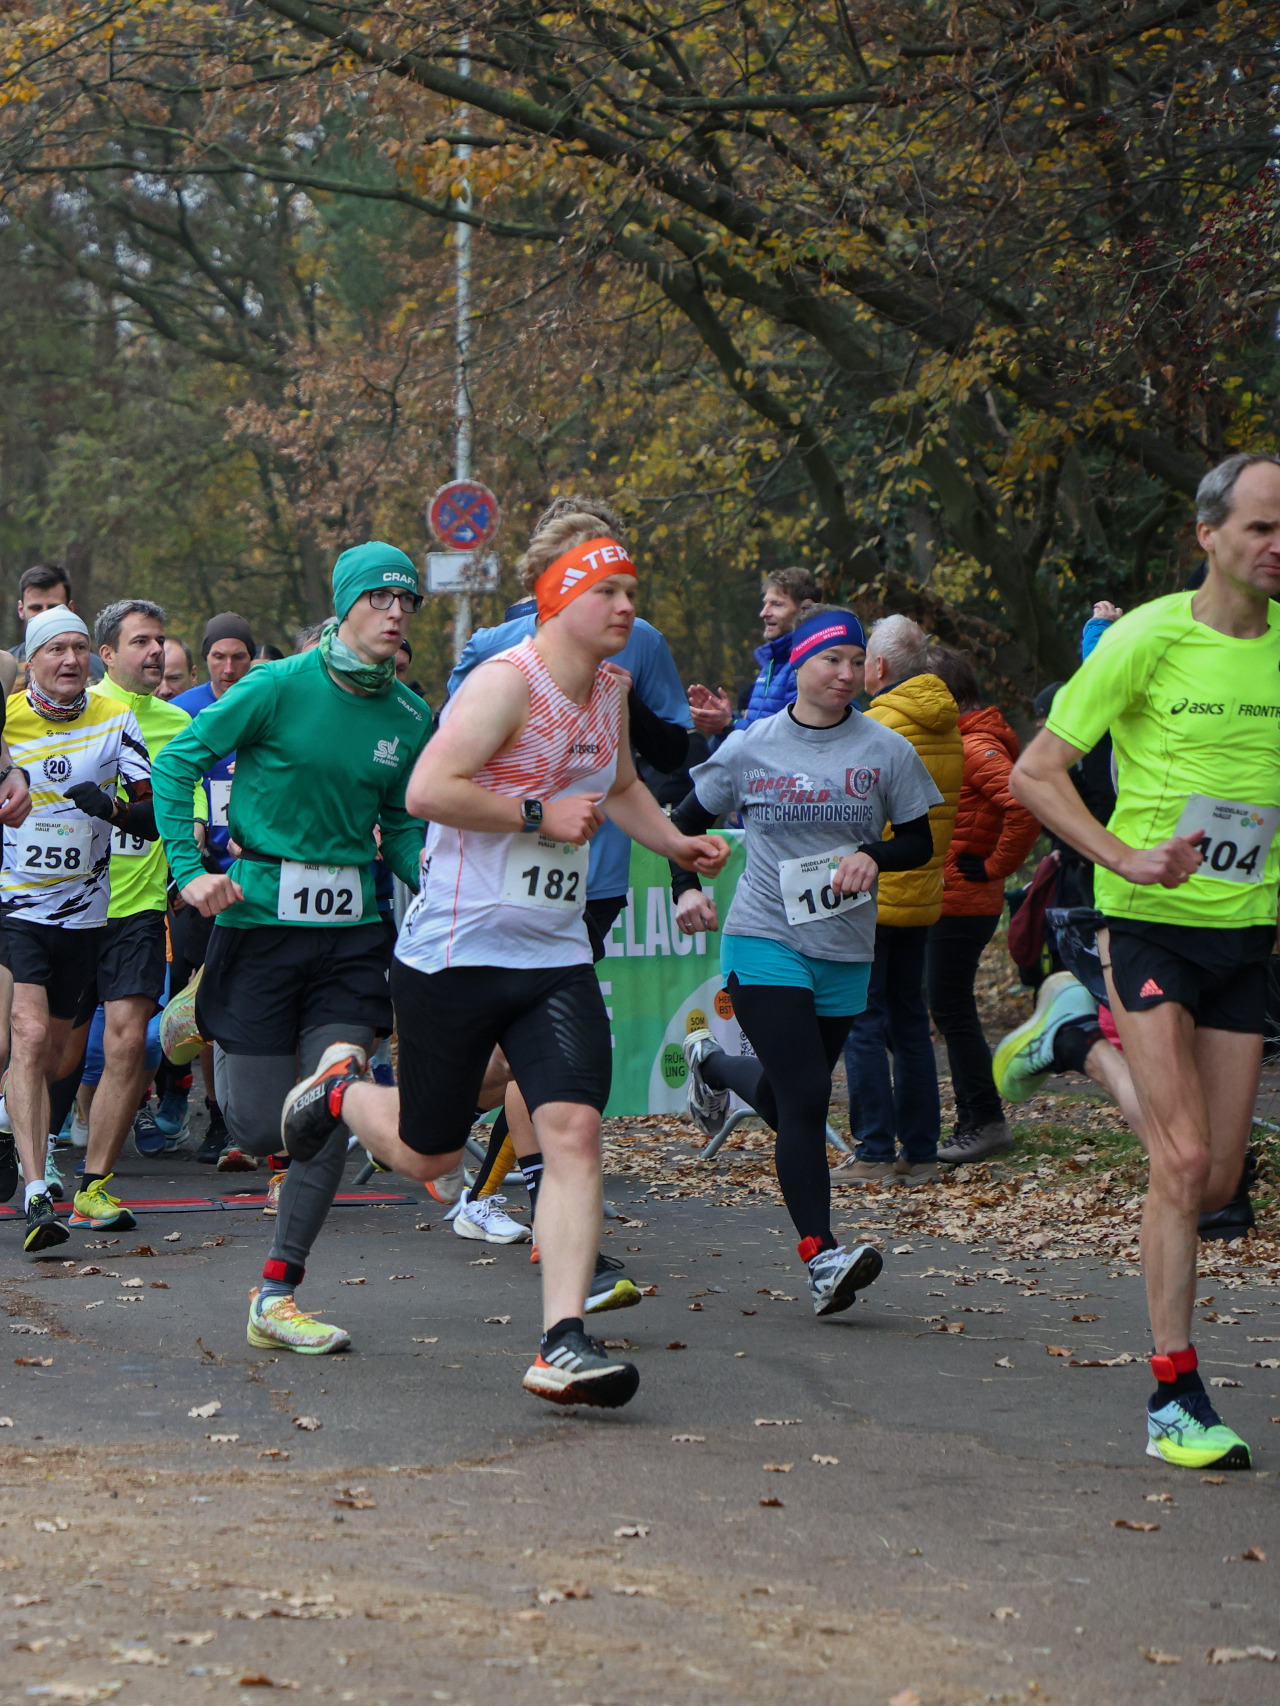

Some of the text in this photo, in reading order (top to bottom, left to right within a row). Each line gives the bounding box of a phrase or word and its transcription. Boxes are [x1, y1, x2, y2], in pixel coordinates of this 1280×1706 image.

[382, 572, 416, 587] CRAFT
[397, 696, 418, 716] CRAFT
[1188, 702, 1225, 715] asics
[373, 735, 400, 758] SV
[49, 760, 66, 775] 20
[743, 768, 766, 781] 2006
[748, 776, 800, 794] TRACK
[778, 789, 830, 803] FIELD
[774, 803, 873, 822] CHAMPIONSHIPS
[1214, 806, 1249, 816] HEIDELAUF
[25, 845, 81, 870] 258
[800, 857, 831, 868] HEIDELAUF
[522, 866, 580, 901] 182
[293, 887, 353, 915] 102
[690, 1016, 705, 1026] SOM
[665, 1065, 685, 1078] LING
[293, 1084, 326, 1115] TERREX
